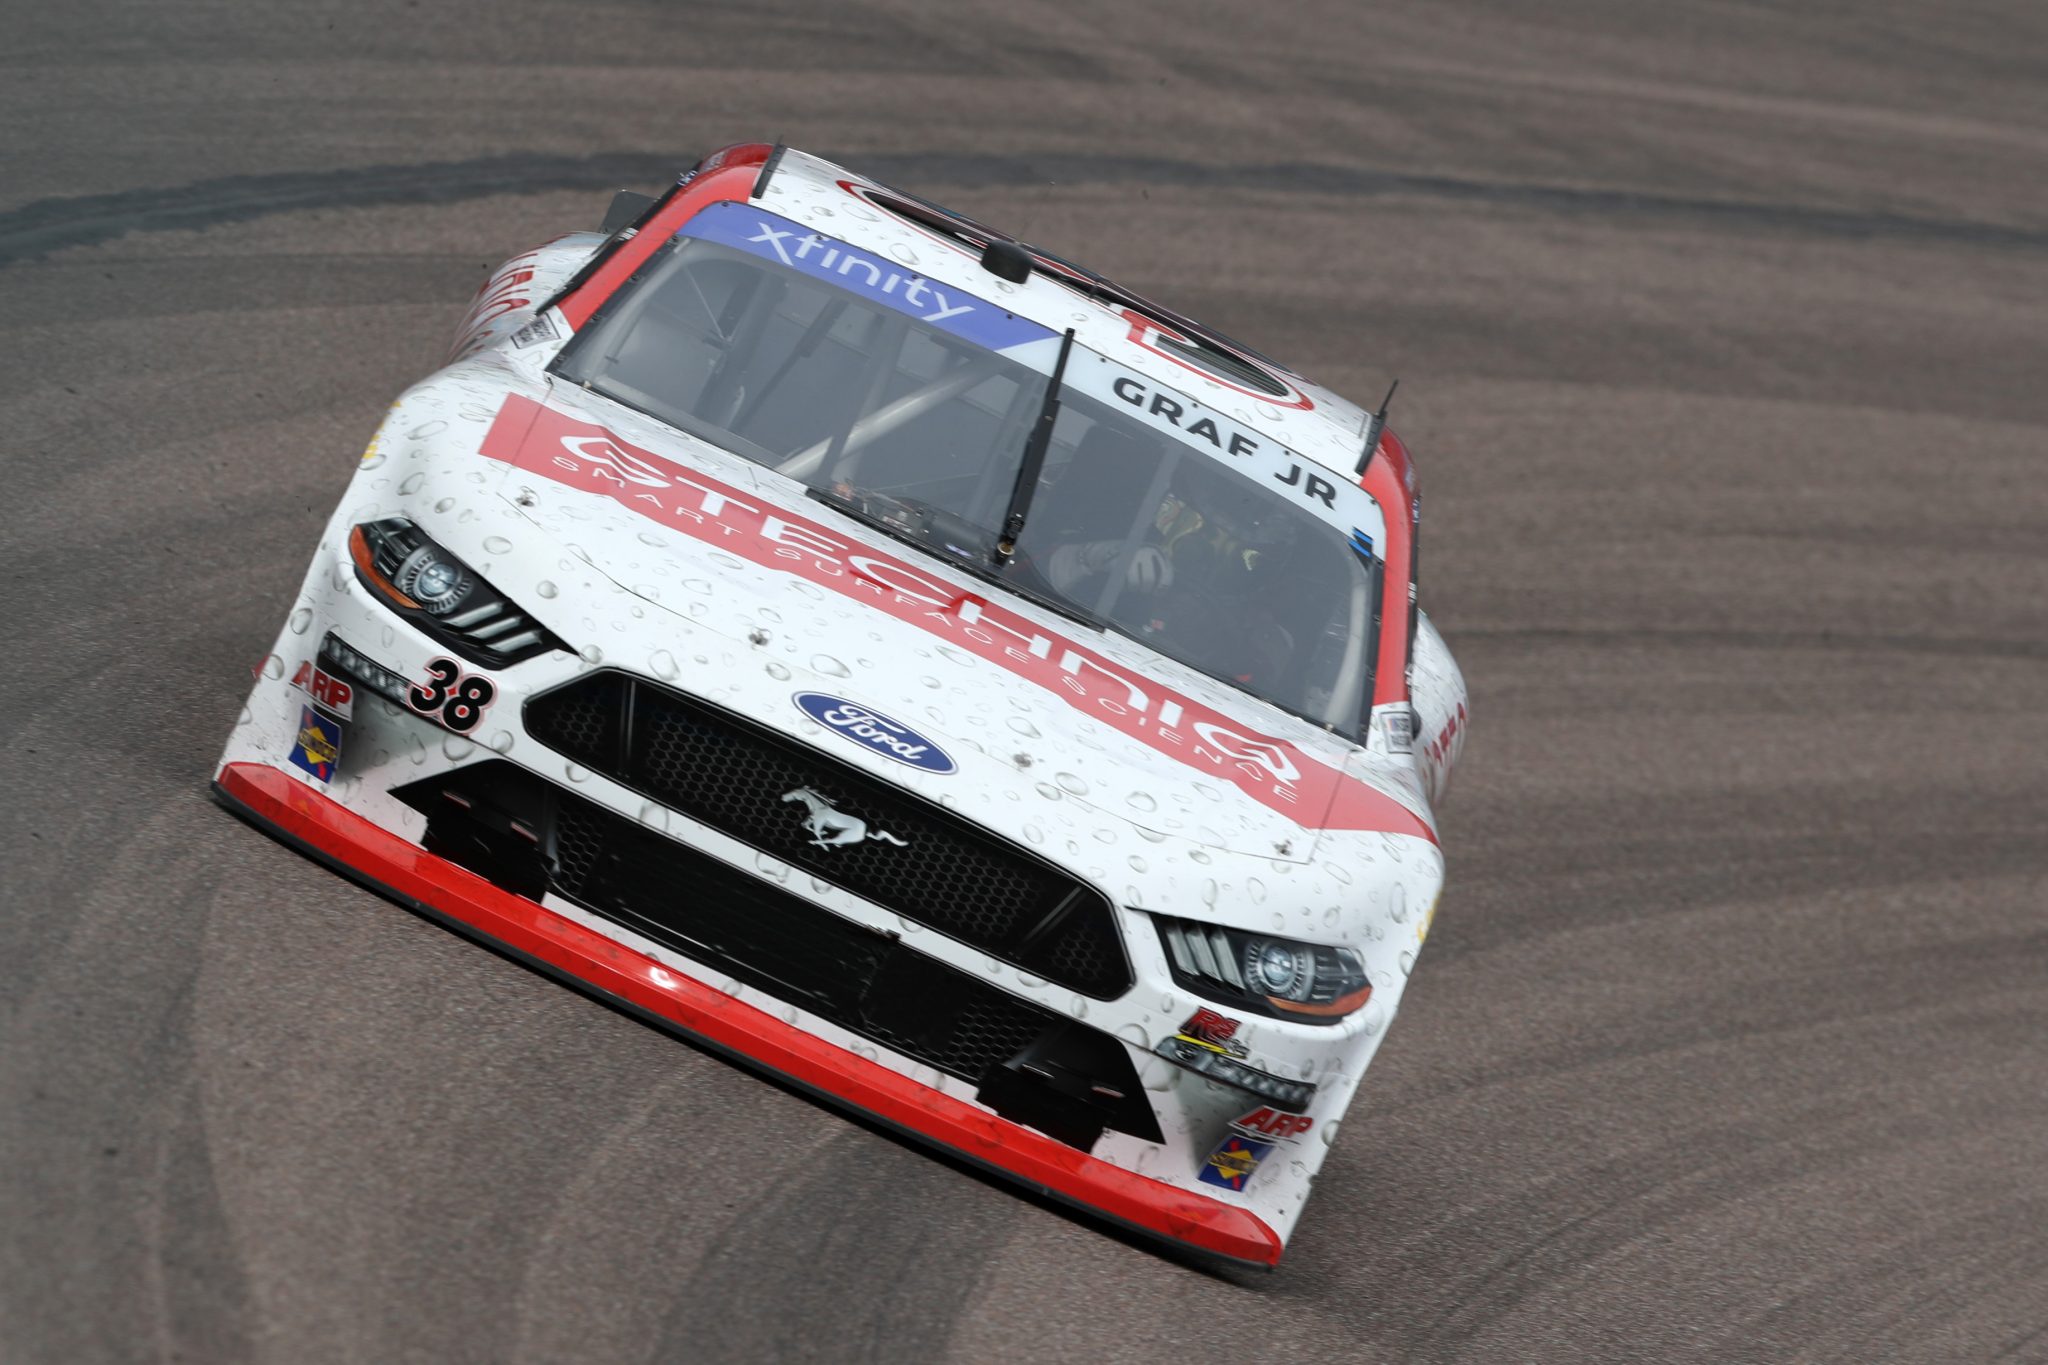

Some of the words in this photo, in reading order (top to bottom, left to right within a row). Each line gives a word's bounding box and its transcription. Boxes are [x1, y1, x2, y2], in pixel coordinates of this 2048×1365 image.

[1112, 377, 1259, 457] GRAF
[1274, 459, 1338, 511] JR
[551, 456, 743, 536] SMART
[774, 547, 1034, 663] SURFACE
[1061, 675, 1297, 803] SCIENCE
[291, 661, 351, 708] ARP
[407, 655, 499, 735] 38
[823, 704, 929, 760] Ford
[1238, 1105, 1314, 1138] ARP
